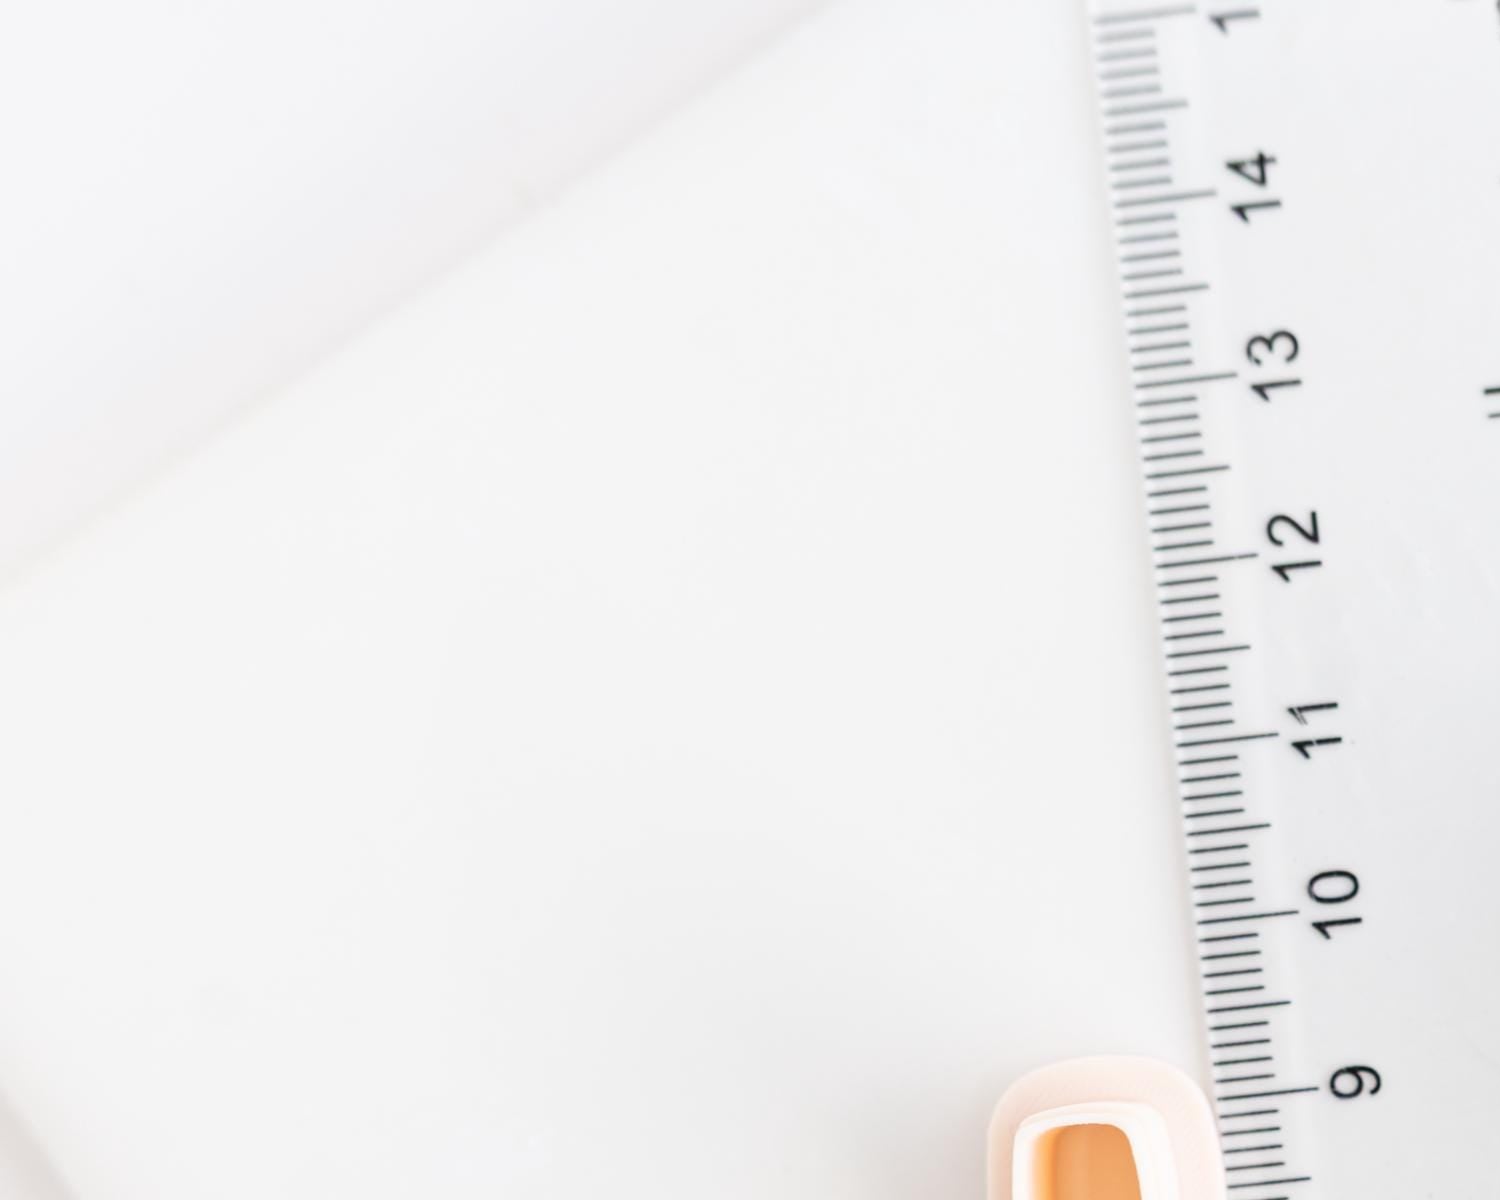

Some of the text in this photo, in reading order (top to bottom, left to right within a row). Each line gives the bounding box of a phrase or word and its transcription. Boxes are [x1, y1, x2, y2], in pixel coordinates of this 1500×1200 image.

[1224, 150, 1283, 224] 14
[1244, 328, 1303, 403] 13
[1265, 509, 1324, 584] 12
[1285, 700, 1344, 761] 11
[1305, 868, 1364, 941] 10
[1327, 1063, 1384, 1101] 9
